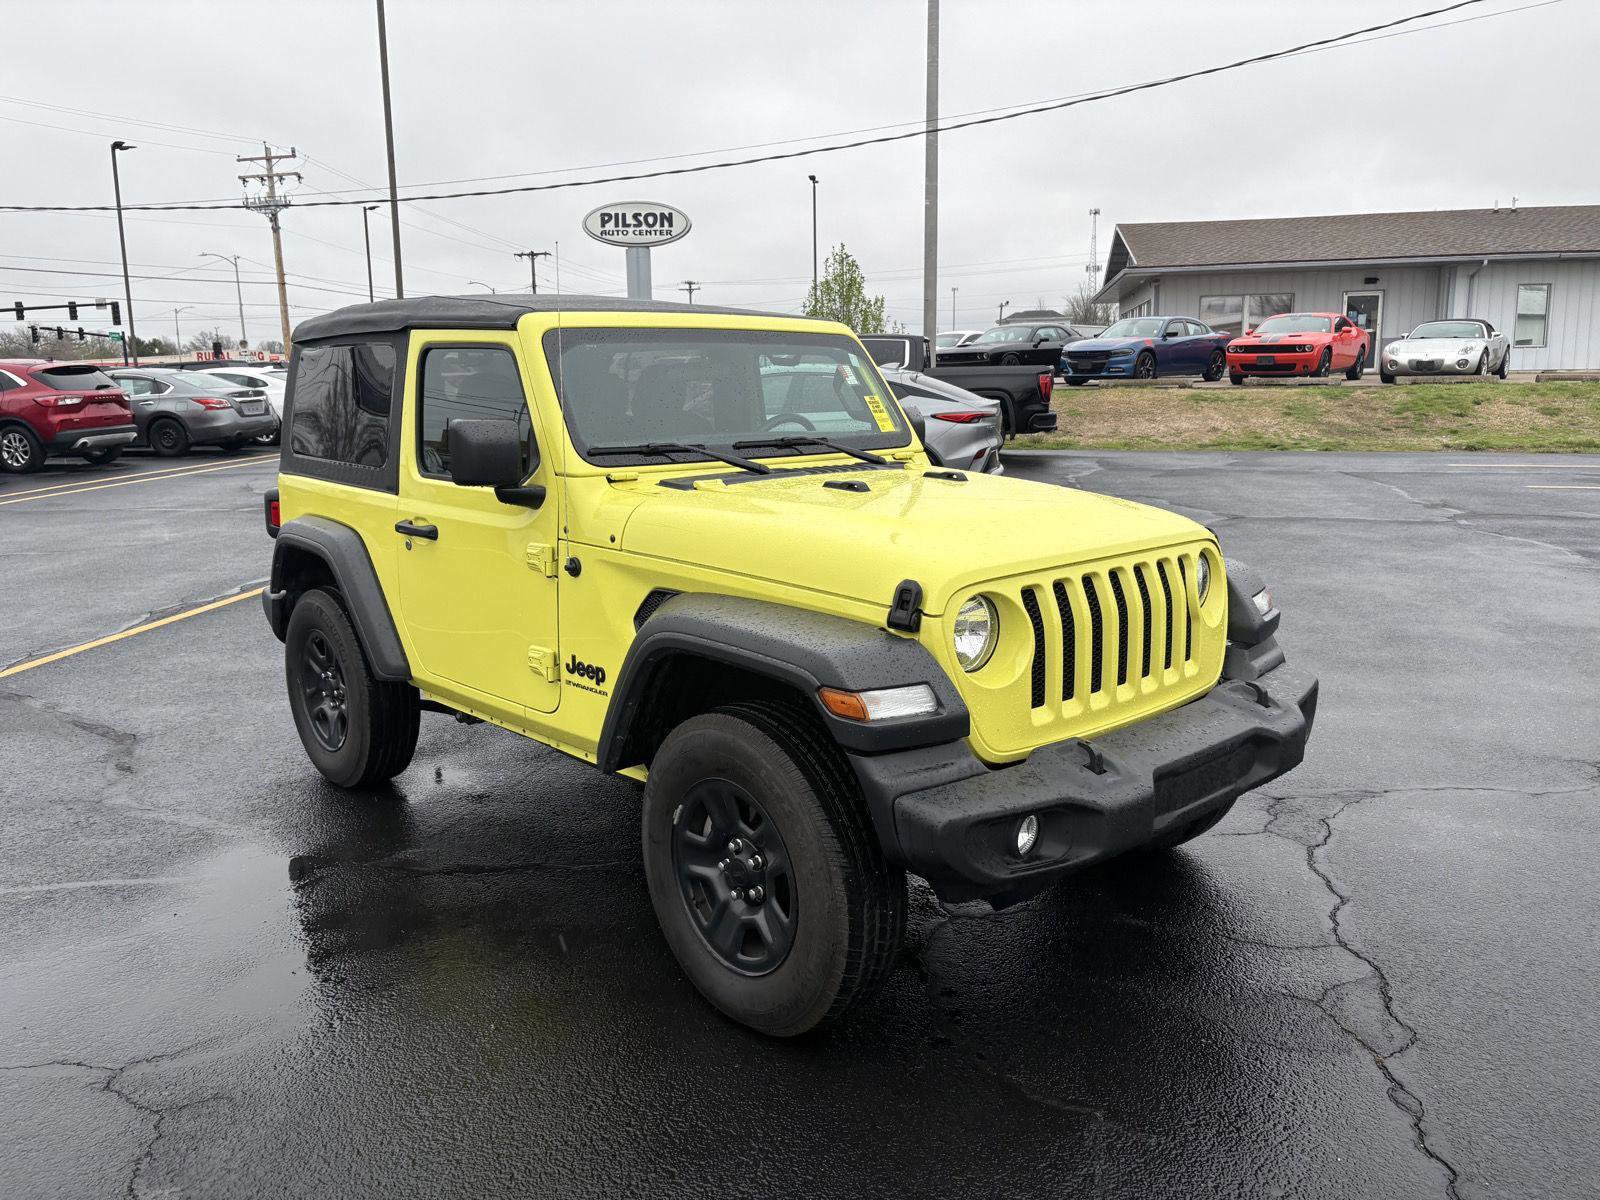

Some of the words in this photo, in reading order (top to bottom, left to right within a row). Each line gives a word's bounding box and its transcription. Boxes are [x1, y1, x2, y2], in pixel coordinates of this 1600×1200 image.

[600, 212, 674, 228] PILSON
[600, 229, 629, 237] AUTO
[632, 229, 673, 237] CENTER
[566, 654, 606, 686] Jeep
[571, 681, 608, 697] WRANGLER
